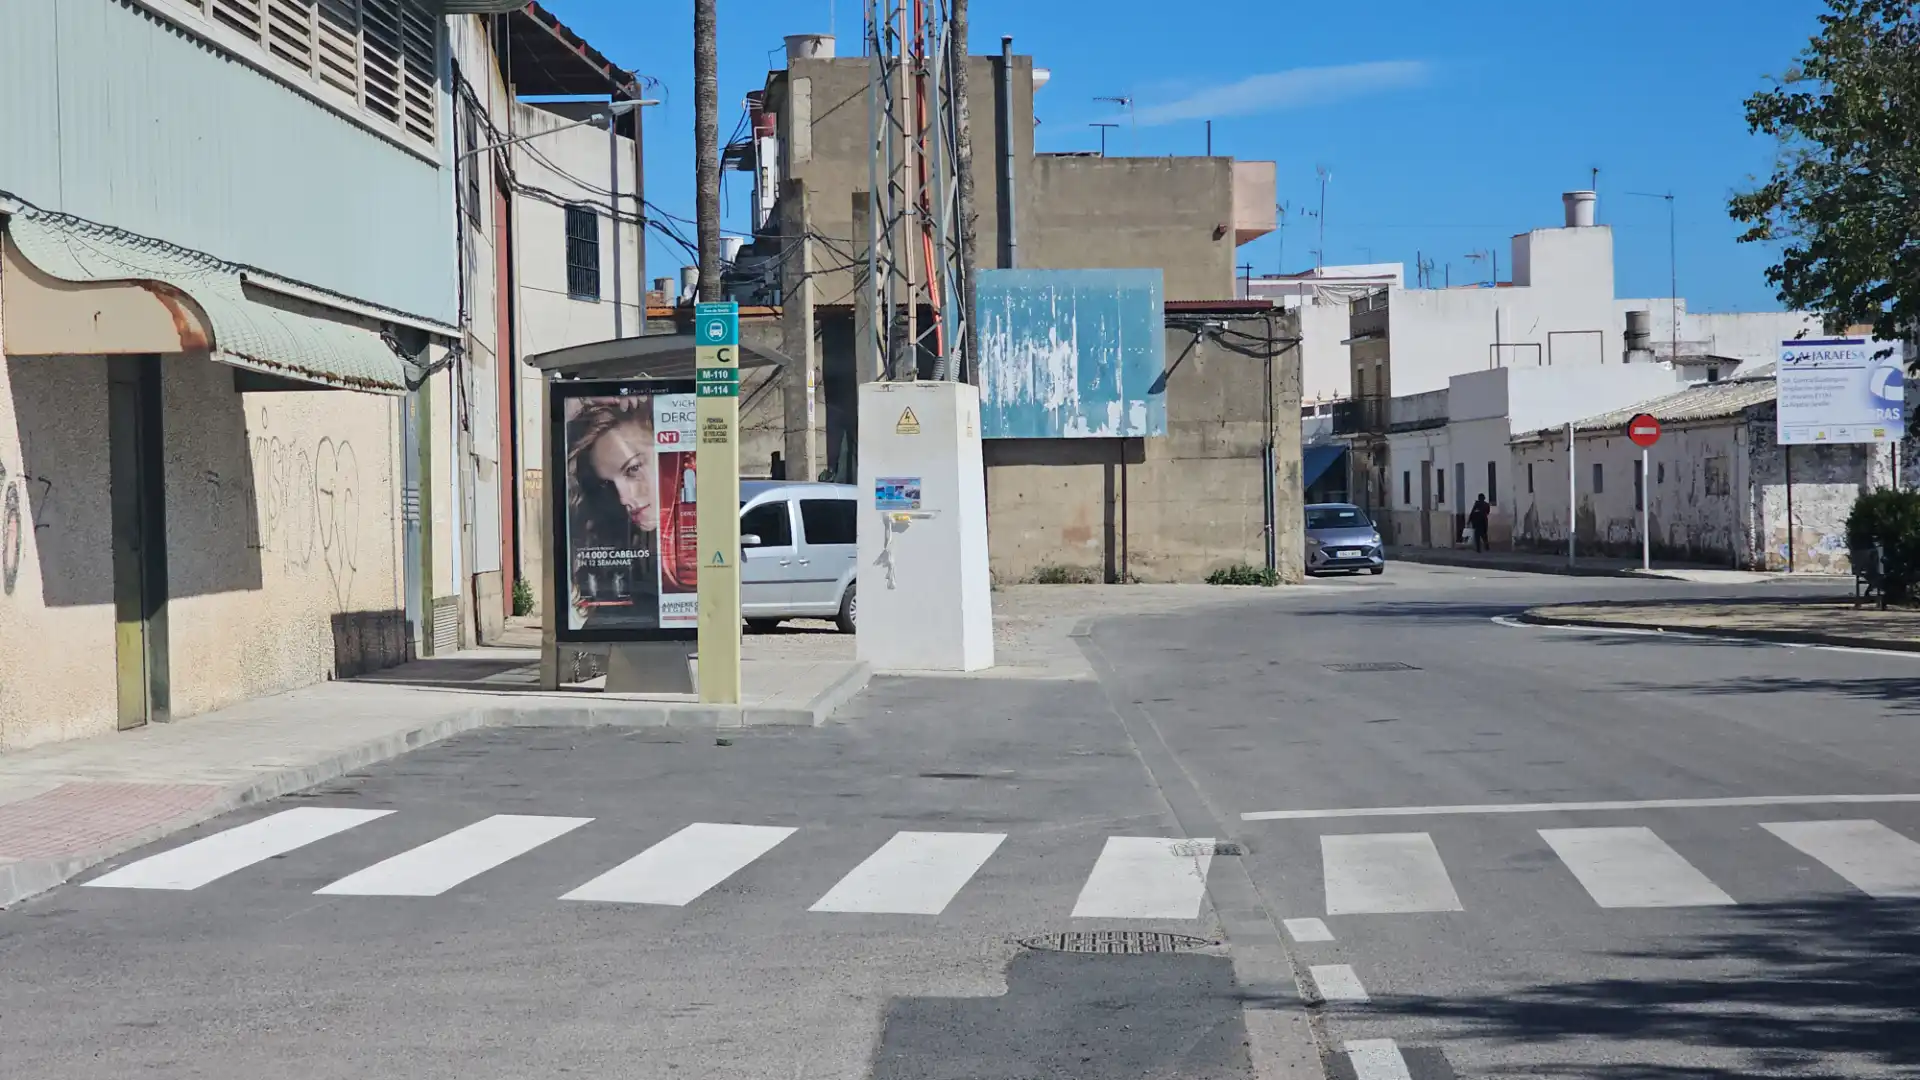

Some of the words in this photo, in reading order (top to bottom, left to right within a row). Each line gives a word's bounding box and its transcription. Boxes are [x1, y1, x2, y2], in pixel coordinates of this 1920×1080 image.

[716, 347, 731, 363] C
[702, 370, 728, 379] M-110
[702, 385, 729, 394] M-114
[671, 400, 696, 408] VICH
[661, 411, 697, 423] DERC
[608, 549, 650, 559] CABELLOS
